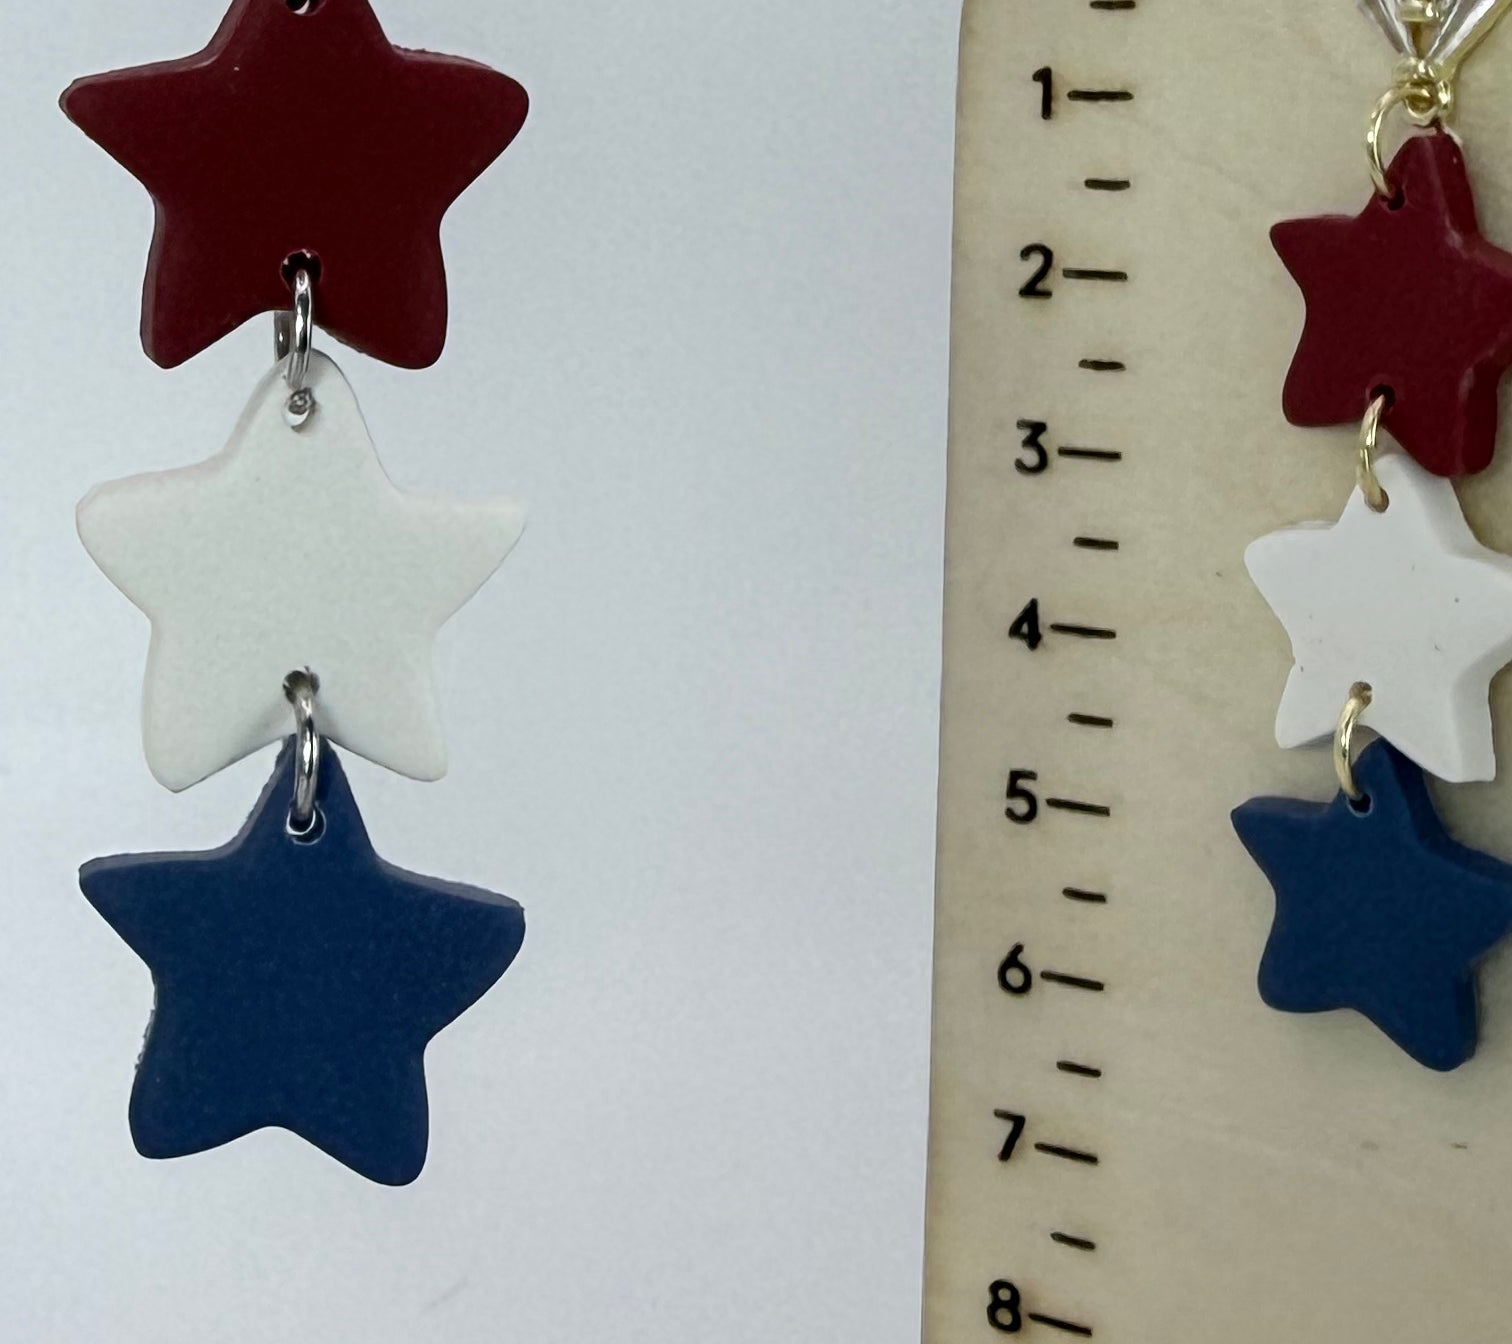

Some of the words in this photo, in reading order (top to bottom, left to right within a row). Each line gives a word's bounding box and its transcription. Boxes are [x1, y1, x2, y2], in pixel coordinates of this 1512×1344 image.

[1031, 65, 1057, 121] 1
[1018, 242, 1055, 301] 2
[1014, 418, 1050, 476] 3
[1007, 597, 1044, 652] 4
[1004, 768, 1039, 826] 5
[996, 942, 1033, 998] 6
[993, 1108, 1027, 1163] 7
[986, 1278, 1027, 1339] 8
